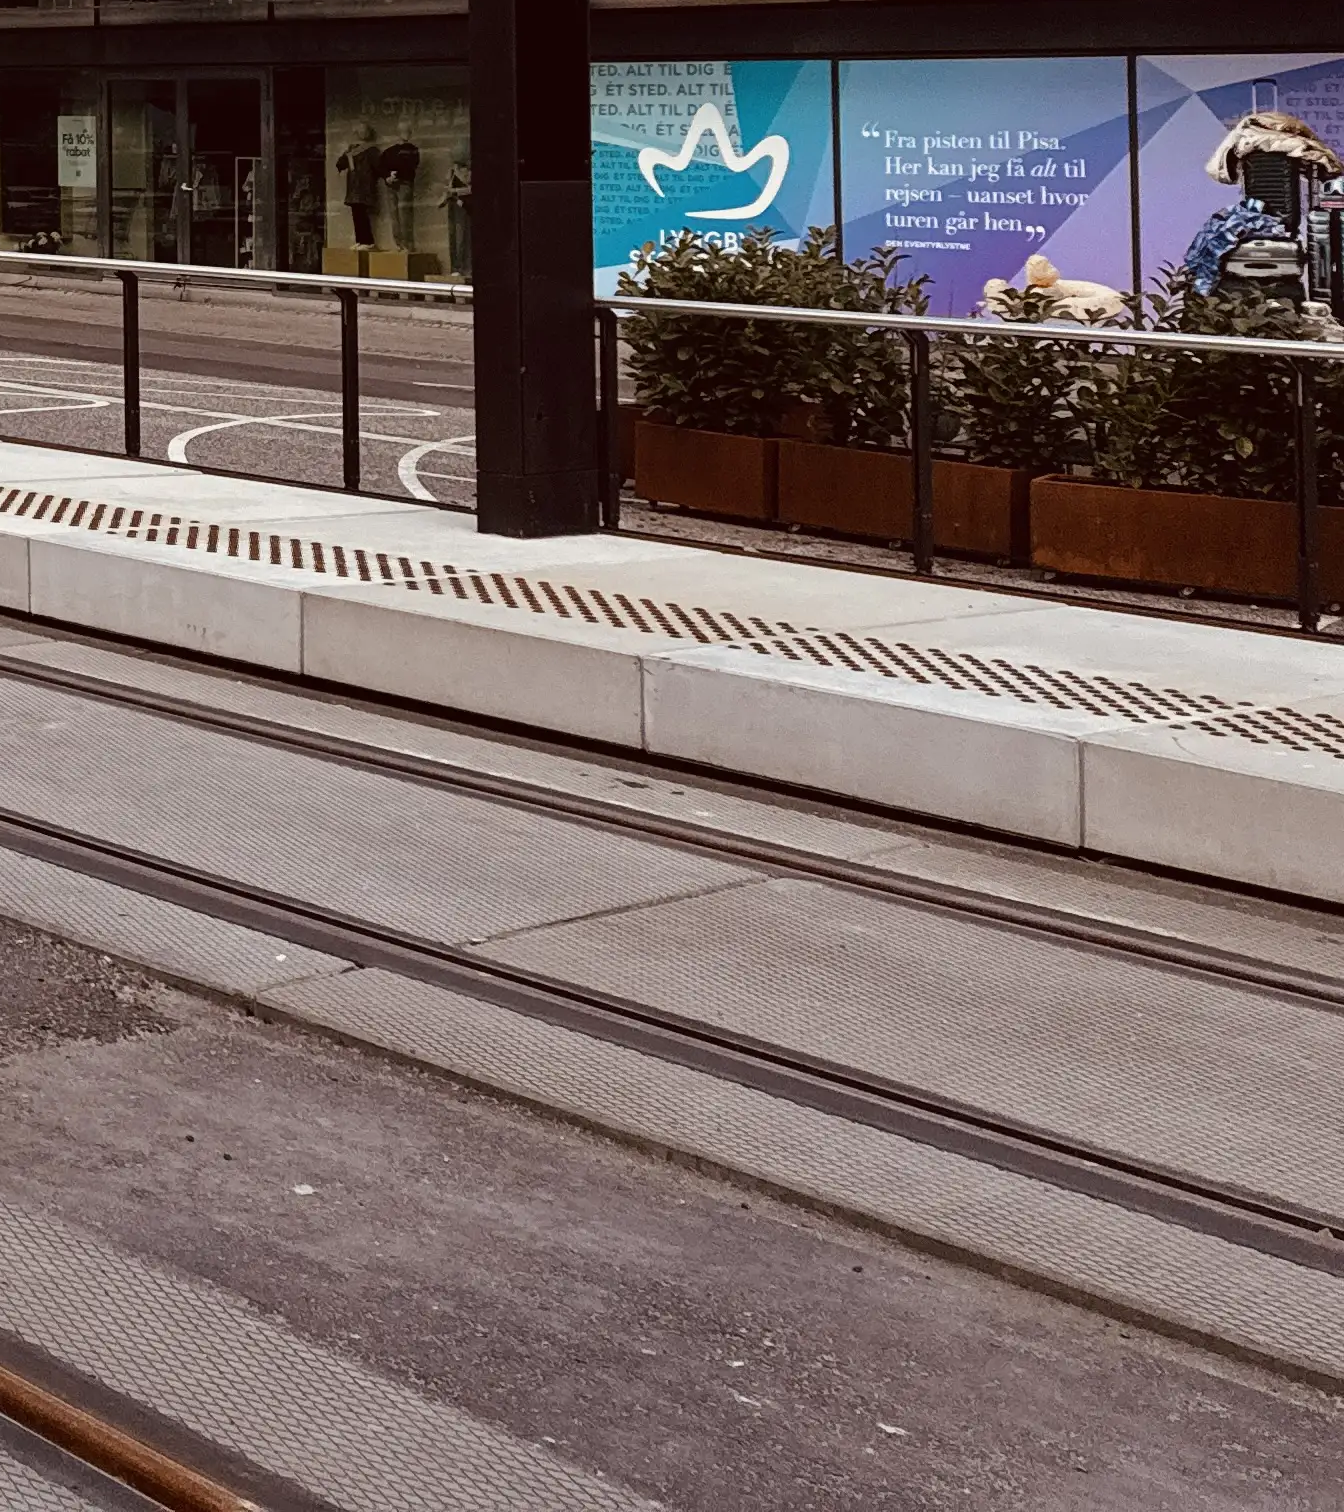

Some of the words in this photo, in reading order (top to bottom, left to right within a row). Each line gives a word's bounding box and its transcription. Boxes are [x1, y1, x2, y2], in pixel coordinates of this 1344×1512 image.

[591, 64, 622, 76] TED.
[626, 64, 653, 76] ALT
[658, 64, 682, 76] TIL
[687, 63, 714, 76] DIG
[676, 83, 704, 96] ALT
[709, 83, 734, 96] TIL
[591, 103, 622, 116] TED.
[626, 103, 654, 116] ALT
[659, 103, 683, 116] TIL
[924, 130, 982, 155] pisten
[989, 130, 1010, 150] til
[1018, 130, 1067, 150] Pisa.
[885, 156, 922, 175] Her
[927, 157, 964, 177] kan
[968, 158, 1000, 183] jeg
[1006, 158, 1026, 177] få
[1031, 157, 1058, 178] alt
[1064, 159, 1087, 178] til
[885, 184, 943, 207] rejsen
[967, 187, 1035, 205] uanset
[1041, 186, 1089, 206] hvor
[885, 212, 939, 229] turen
[946, 210, 979, 235] går
